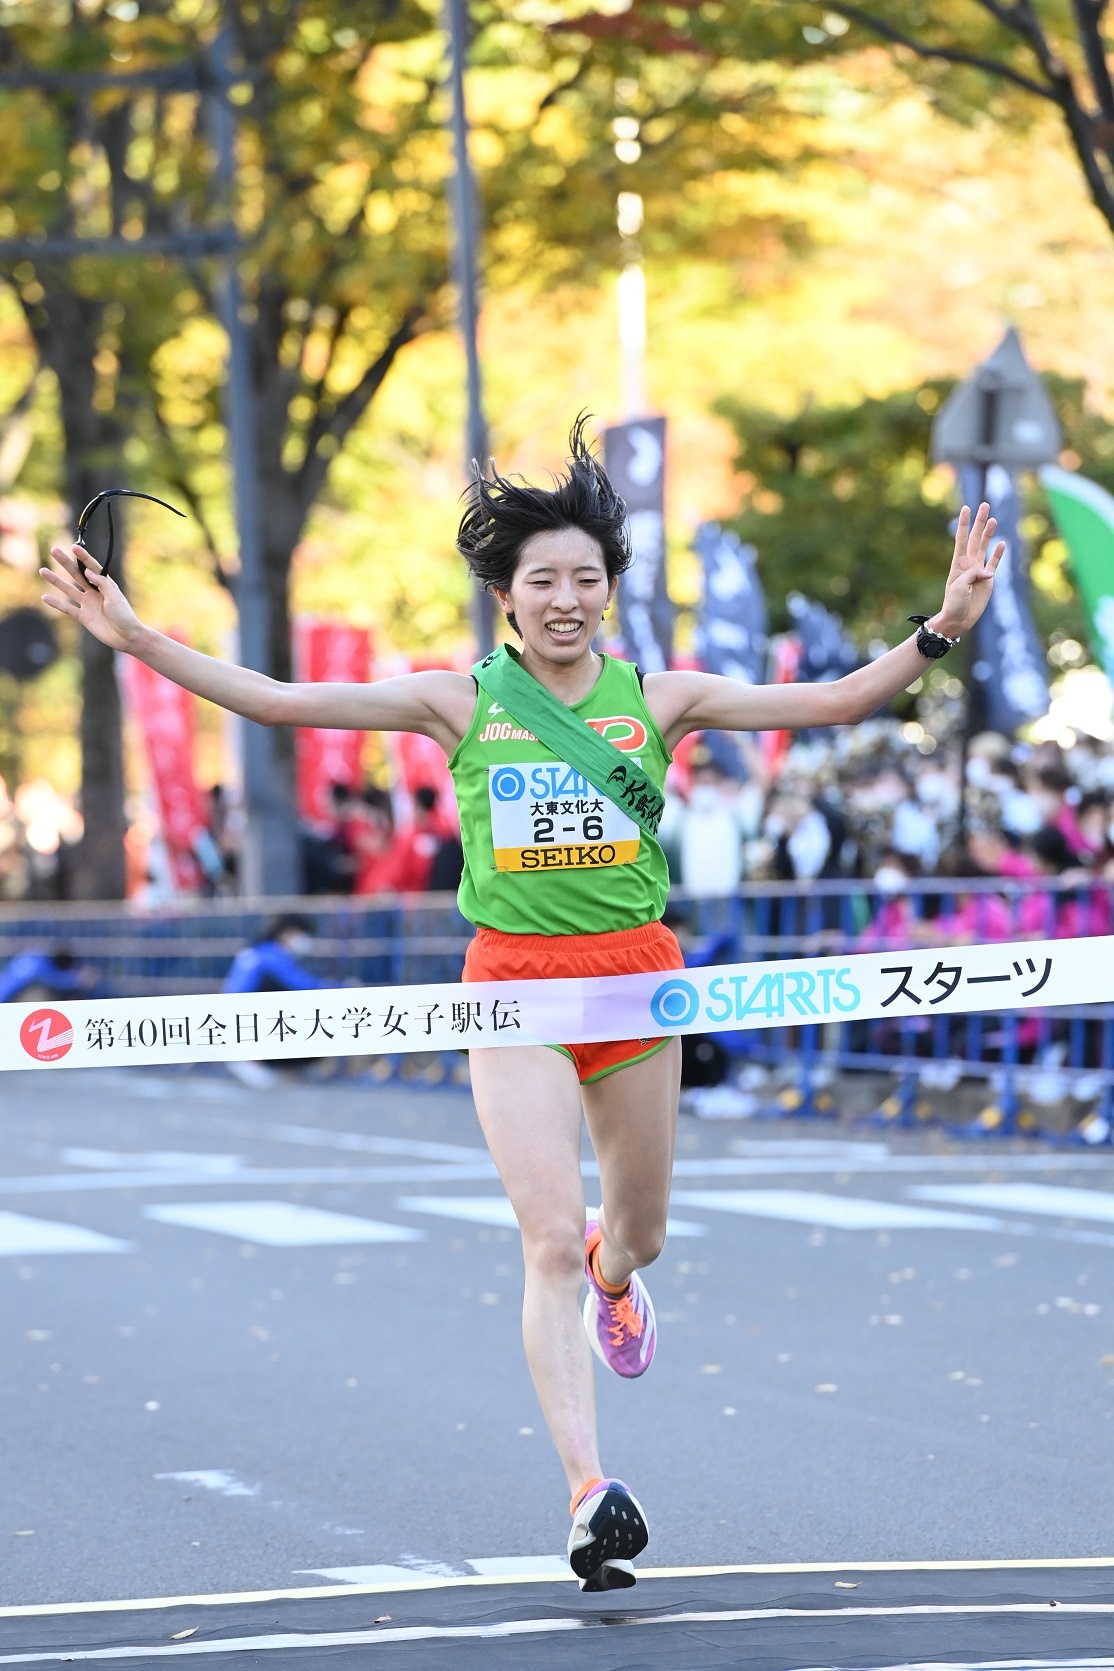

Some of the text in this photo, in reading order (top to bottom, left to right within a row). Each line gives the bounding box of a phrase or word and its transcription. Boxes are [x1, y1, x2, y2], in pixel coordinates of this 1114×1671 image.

[479, 722, 539, 743] JOGMAS
[530, 799, 604, 816] 大東文化大
[520, 845, 616, 868] SEIKO
[880, 958, 1053, 1008] スターツ
[84, 999, 521, 1050] 第40回全日本大学女子駅伝
